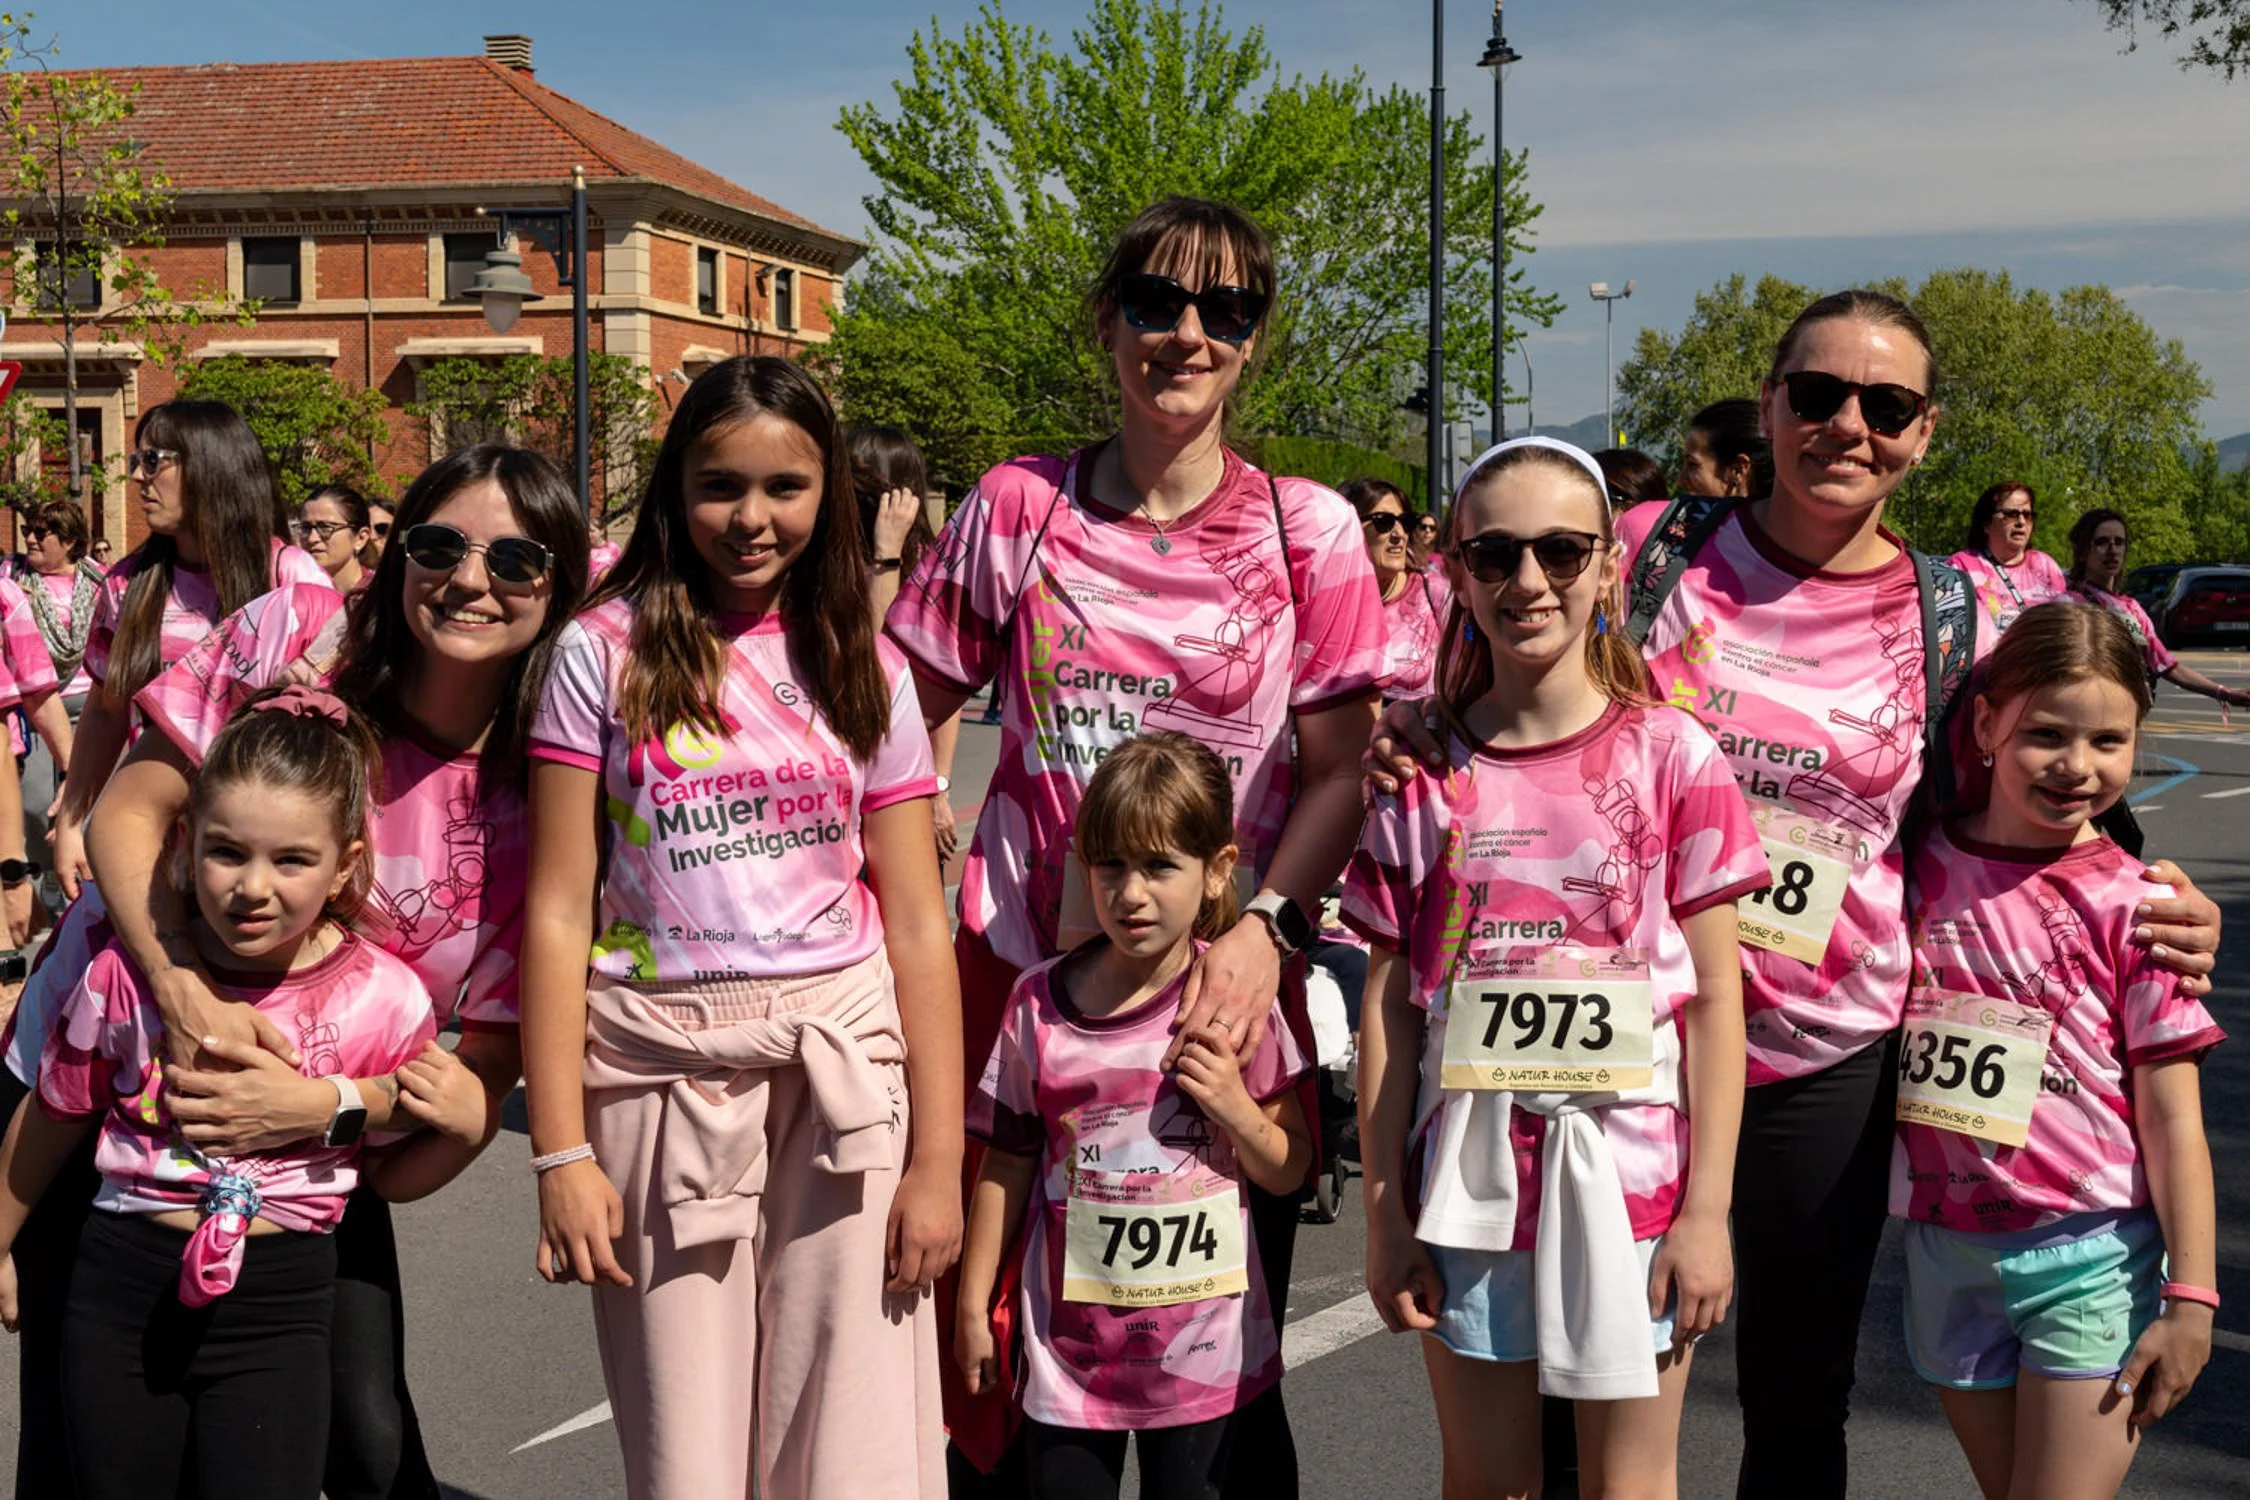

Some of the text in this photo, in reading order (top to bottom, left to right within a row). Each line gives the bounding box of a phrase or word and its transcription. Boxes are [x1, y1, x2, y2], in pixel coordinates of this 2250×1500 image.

[1058, 624, 1088, 650] XI
[1054, 660, 1171, 698] Carrera
[1702, 685, 1738, 716] XI
[1056, 703, 1136, 732] por la
[650, 752, 850, 806] Carrera de la
[1751, 771, 1780, 799] la
[655, 794, 769, 841] Mujer
[776, 791, 828, 824] por
[668, 817, 846, 873] Investigació
[1466, 882, 1489, 907] XI
[686, 929, 735, 943] La Rioja
[1469, 916, 1564, 939] Carrera
[1480, 992, 1614, 1051] 7973
[1508, 1070, 1550, 1081] NATUR
[1080, 1144, 1101, 1163] XI
[1098, 1212, 1217, 1270] 7974
